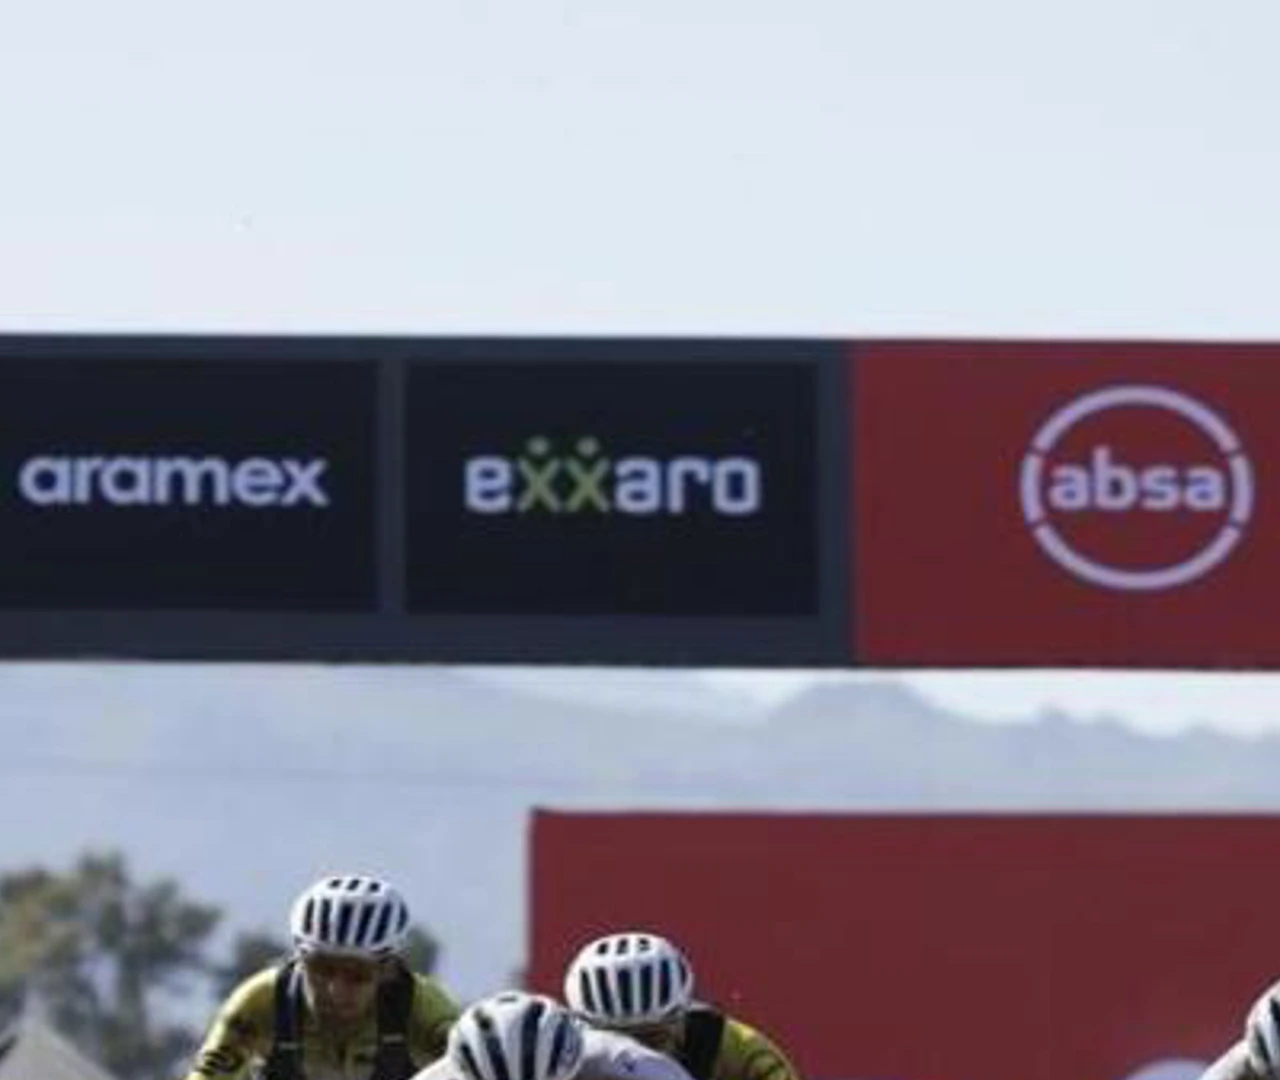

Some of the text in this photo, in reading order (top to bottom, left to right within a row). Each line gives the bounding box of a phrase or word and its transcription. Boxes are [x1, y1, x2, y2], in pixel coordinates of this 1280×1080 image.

[20, 456, 329, 505] aramex
[464, 437, 760, 513] exxaro
[1048, 444, 1226, 510] absa
